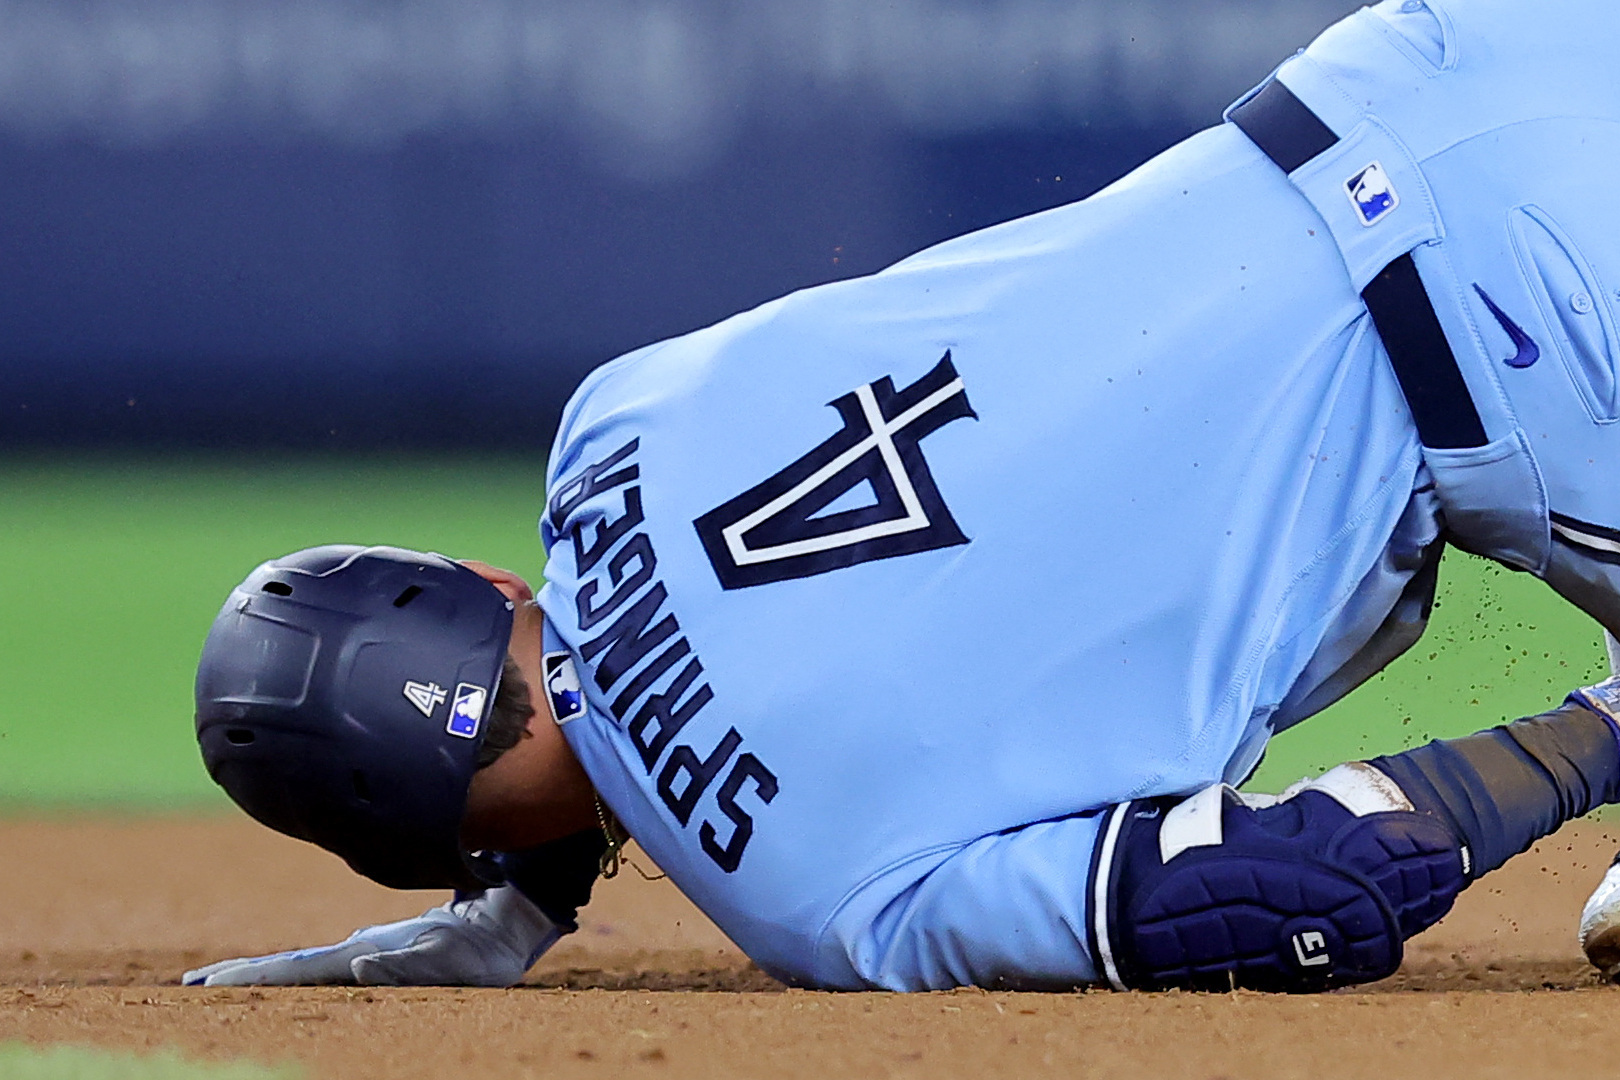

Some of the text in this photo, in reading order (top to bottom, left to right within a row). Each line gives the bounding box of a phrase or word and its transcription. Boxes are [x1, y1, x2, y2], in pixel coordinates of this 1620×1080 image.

[693, 348, 979, 591] 4
[403, 681, 448, 718] 4
[548, 436, 779, 874] SPRINGER
